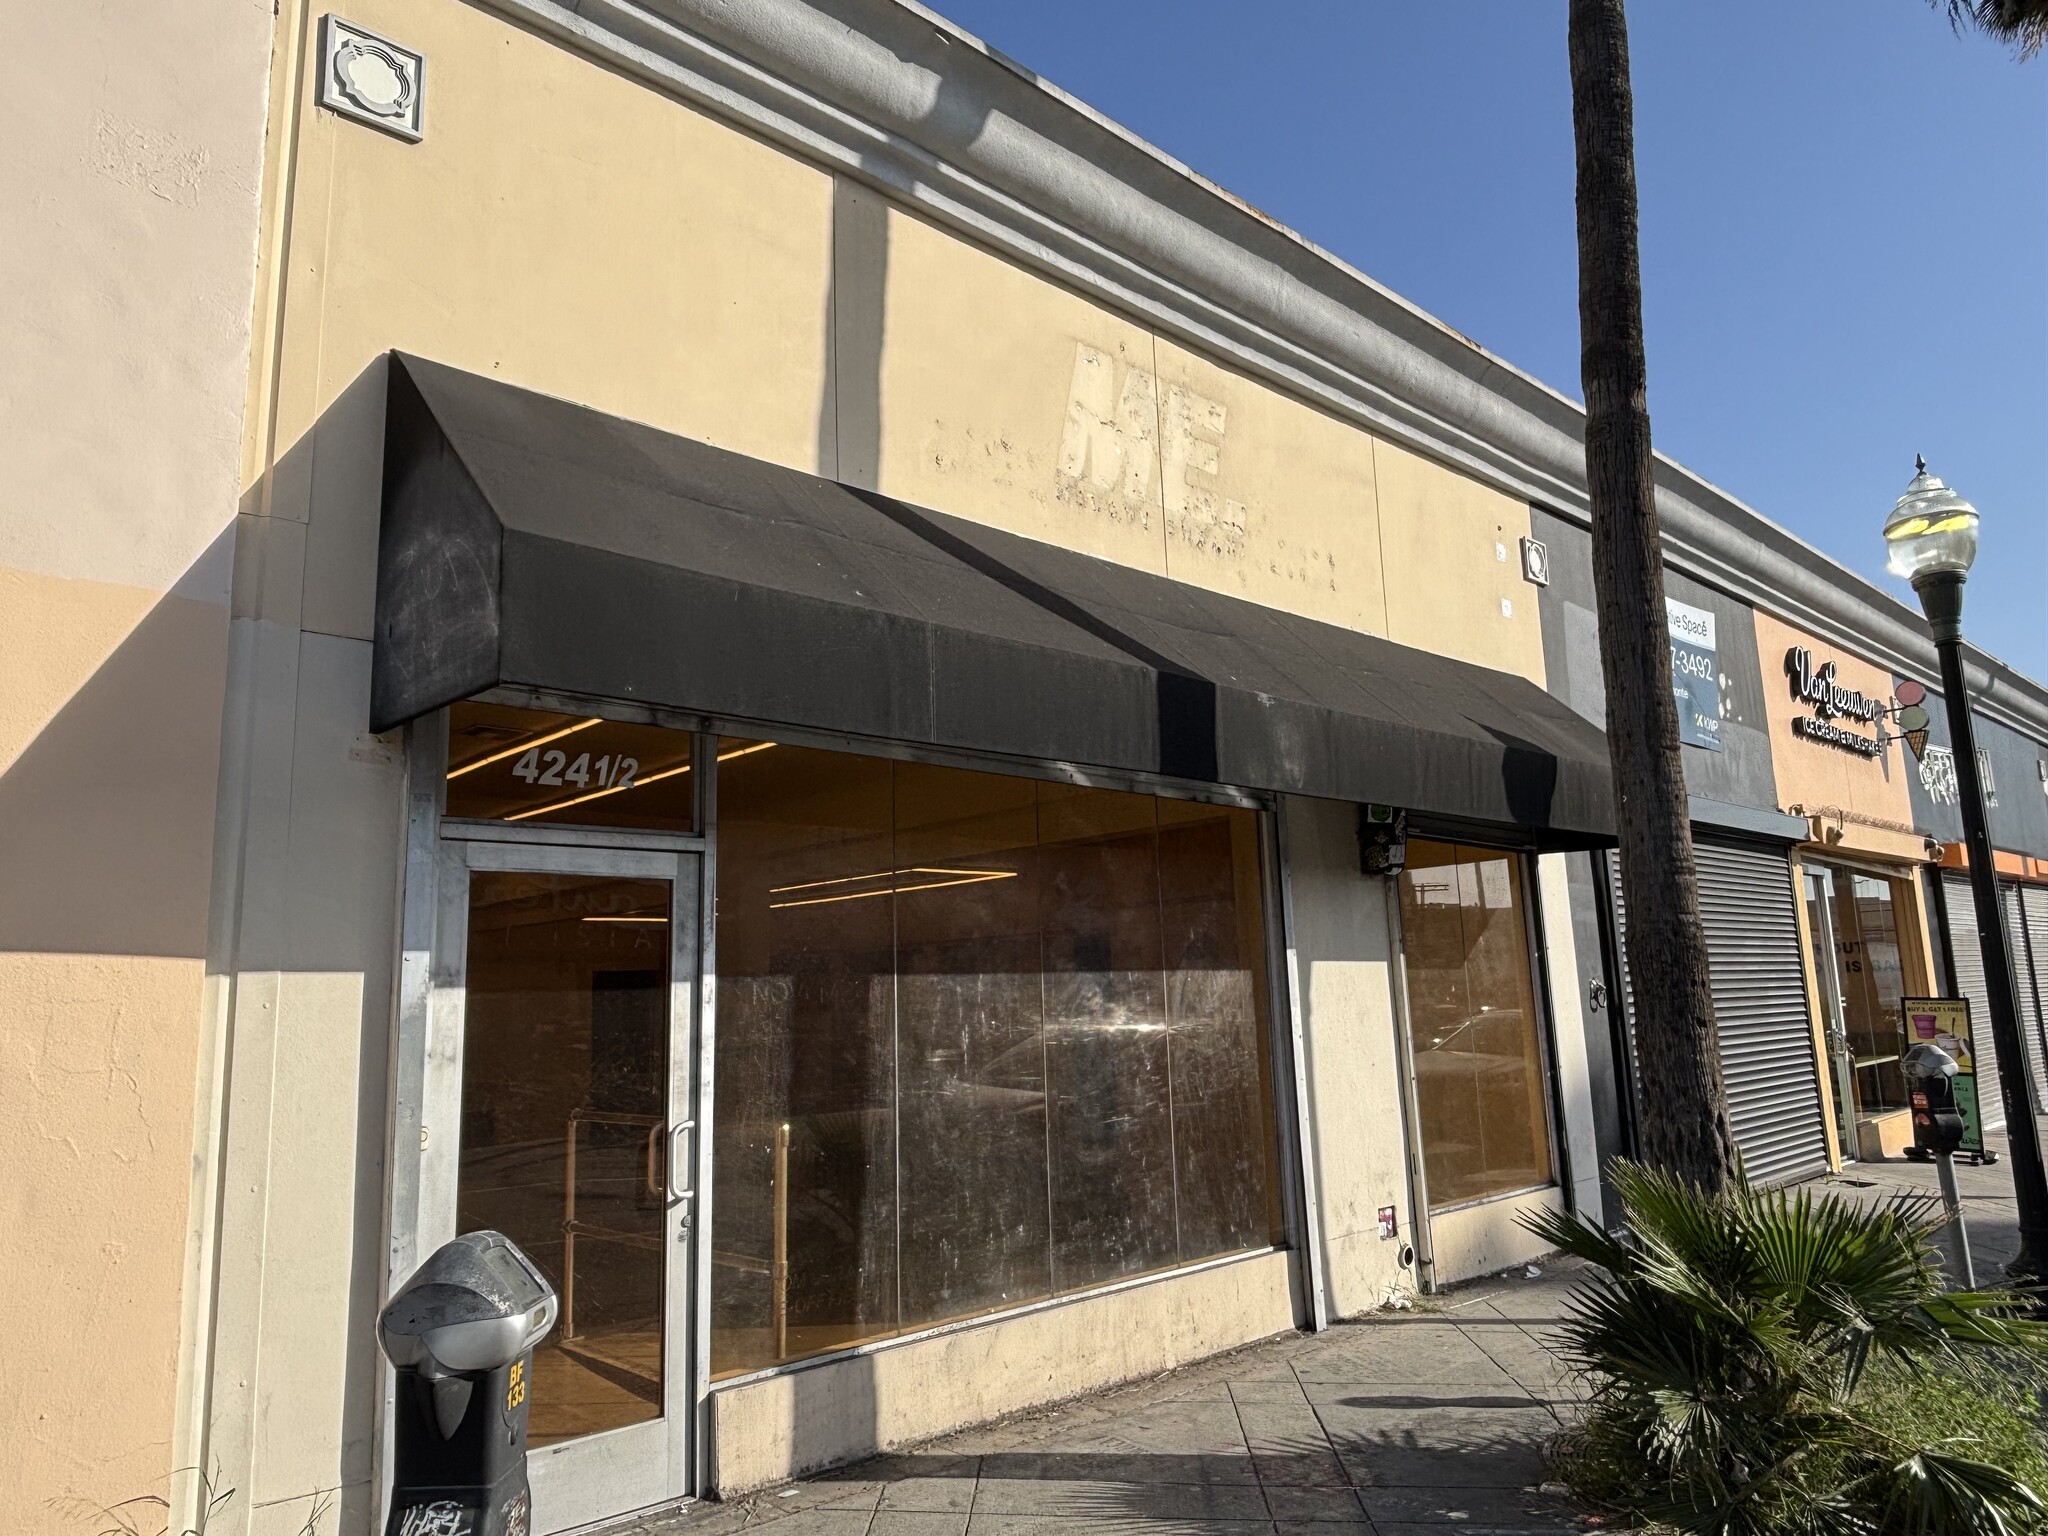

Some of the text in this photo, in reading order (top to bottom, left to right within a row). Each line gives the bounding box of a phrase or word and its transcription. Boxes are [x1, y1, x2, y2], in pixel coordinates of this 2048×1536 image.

[1671, 646, 1713, 682] 7-3492
[1795, 645, 1878, 721] Van Leeuwen
[1802, 716, 1816, 733] ICE
[509, 1360, 525, 1390] BF
[507, 1380, 525, 1411] 133
